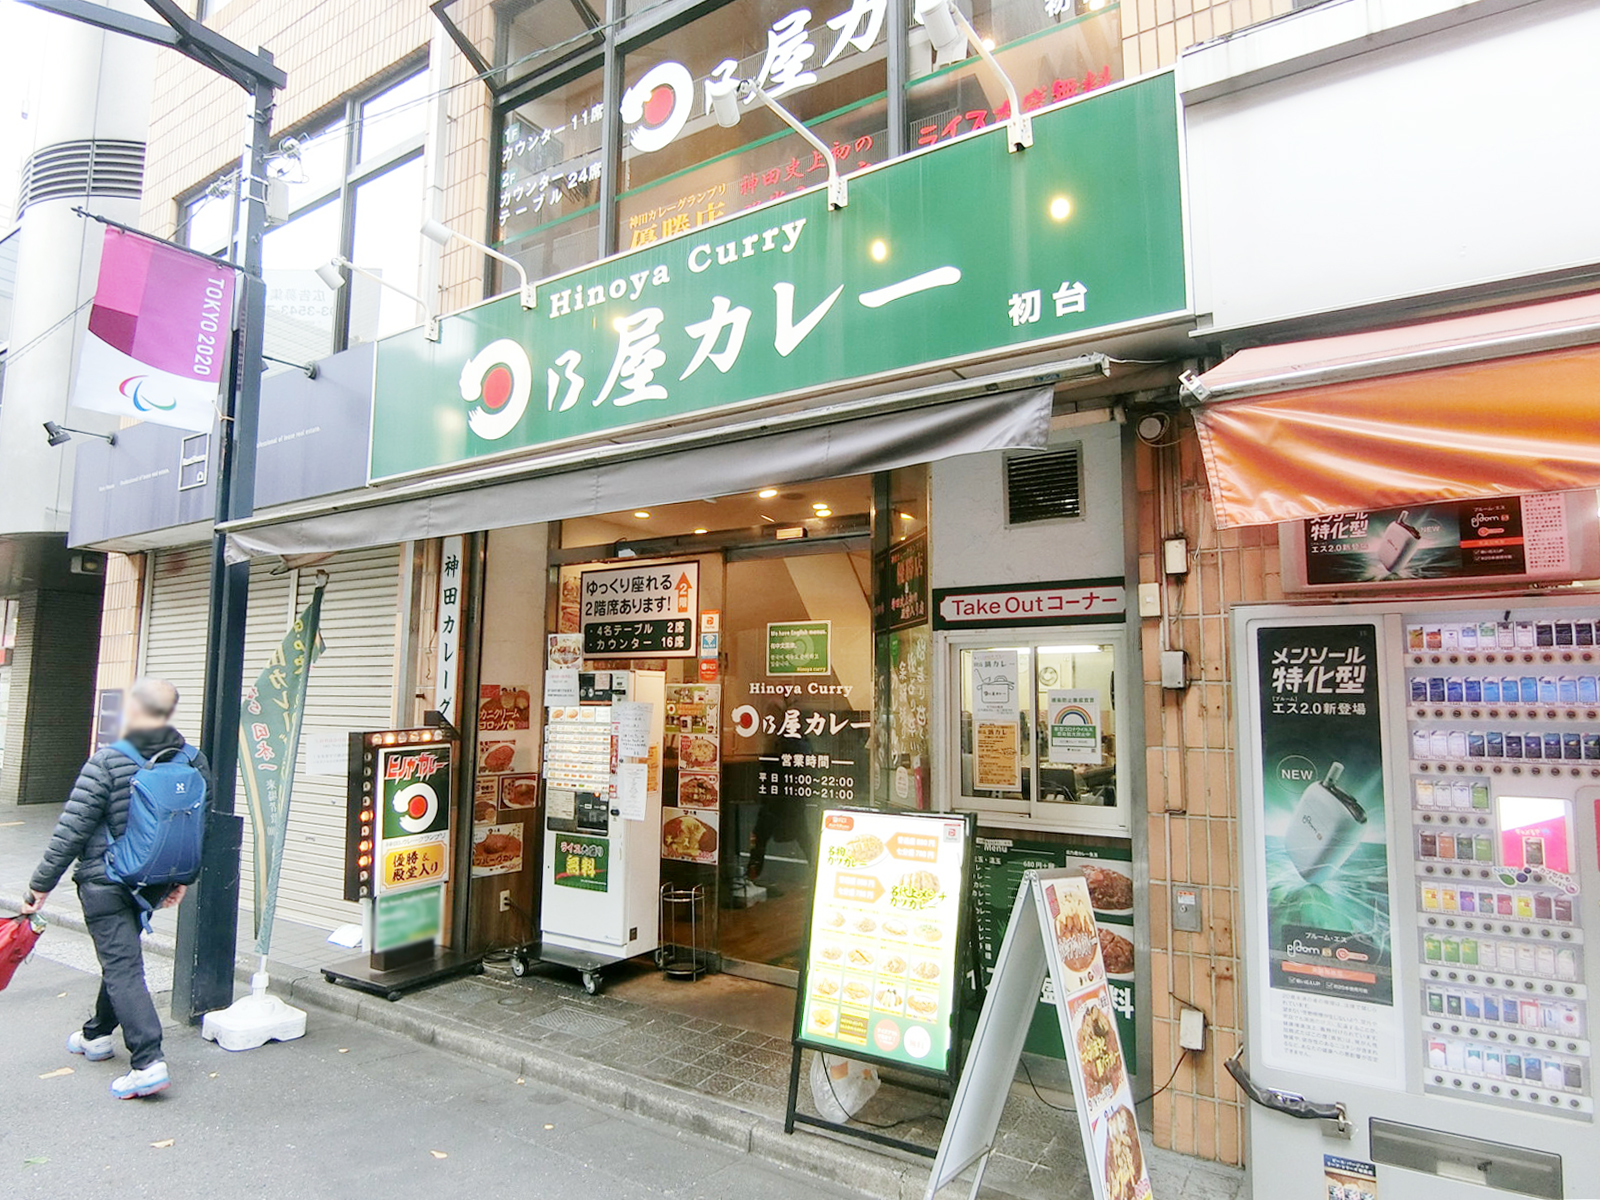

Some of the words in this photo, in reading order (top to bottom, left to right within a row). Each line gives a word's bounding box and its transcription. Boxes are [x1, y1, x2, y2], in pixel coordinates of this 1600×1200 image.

[502, 125, 566, 163] カウンター
[504, 127, 518, 143] 1F
[500, 173, 564, 208] カウンター
[567, 162, 602, 190] 24席
[501, 172, 516, 188] 2F
[499, 188, 563, 227] テーブル
[629, 183, 726, 230] 神田カレーグランプリ
[549, 262, 671, 320] Hinoya
[687, 217, 807, 274] Curry
[200, 278, 225, 333] TOKYO
[1008, 280, 1088, 327] 初台
[193, 333, 216, 375] 2020
[1310, 519, 1369, 541] 特化型
[586, 574, 672, 596] ゆっくり座れる
[951, 599, 1001, 616] Take
[1004, 596, 1044, 613] Out
[1047, 591, 1117, 611] コーナー
[667, 621, 685, 635] 2席
[596, 639, 652, 650] カウンター
[661, 636, 685, 649] 16席
[1271, 646, 1367, 664] メンソール
[1271, 665, 1367, 694] 特化型
[749, 682, 802, 697] Hinoya
[807, 682, 853, 697] Curry
[480, 708, 520, 720] カニクリーム
[1272, 702, 1366, 715] エス2.0新登場
[479, 720, 508, 730] コロッケ
[781, 753, 830, 769] 営業時間
[758, 772, 779, 783] 平日
[1281, 769, 1313, 780] NEW
[758, 785, 779, 795] 土日
[393, 851, 418, 868] 優勝
[421, 853, 430, 862] &
[392, 861, 439, 881] 殿堂入り
